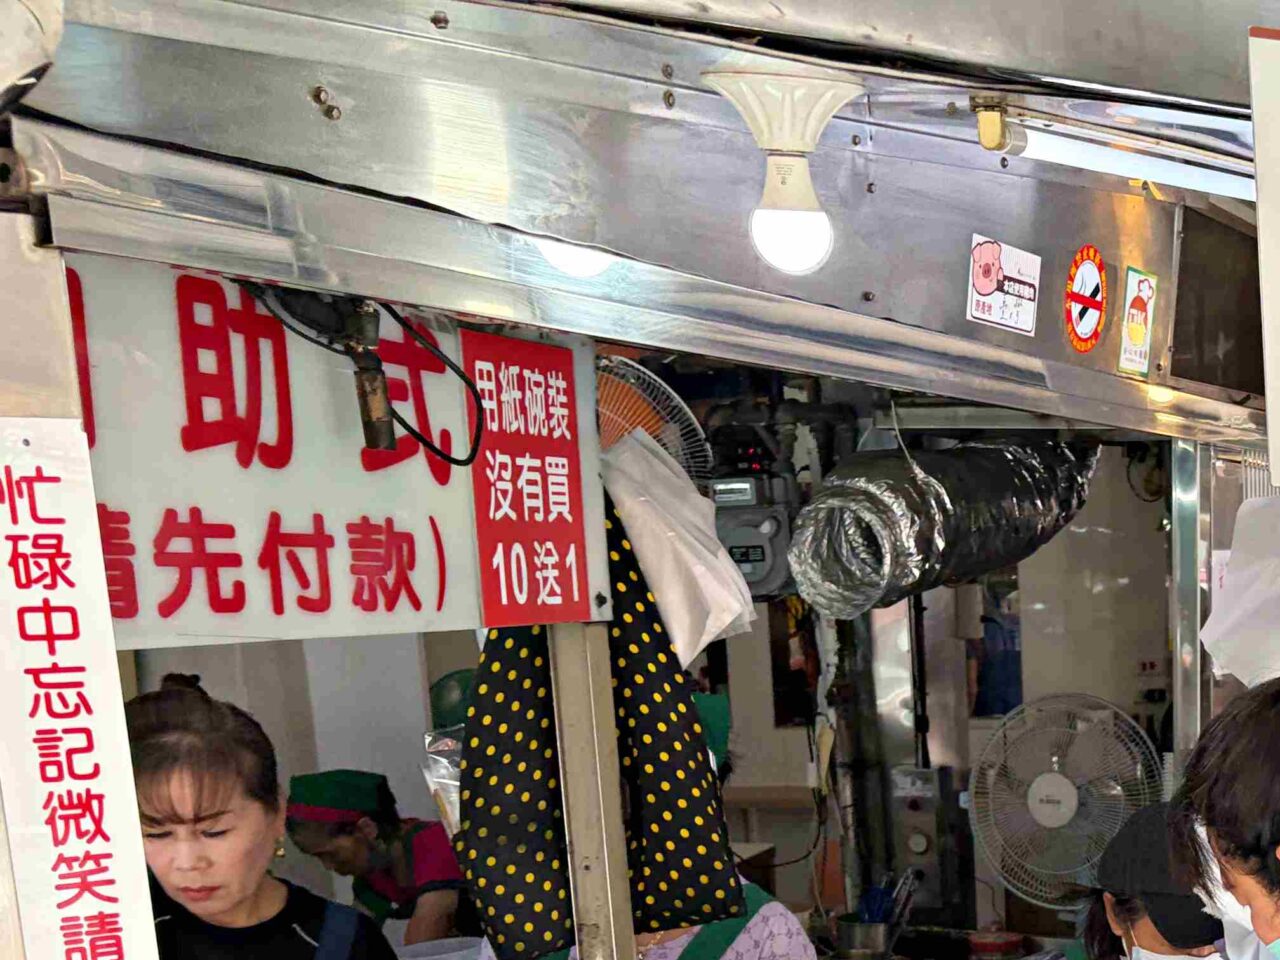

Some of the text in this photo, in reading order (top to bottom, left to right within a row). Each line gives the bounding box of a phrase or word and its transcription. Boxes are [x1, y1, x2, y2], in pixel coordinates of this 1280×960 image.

[66, 268, 452, 486] 助式
[475, 360, 571, 440] 用紙碗裝
[485, 450, 573, 523] 沒有買
[492, 541, 580, 606] 10送1
